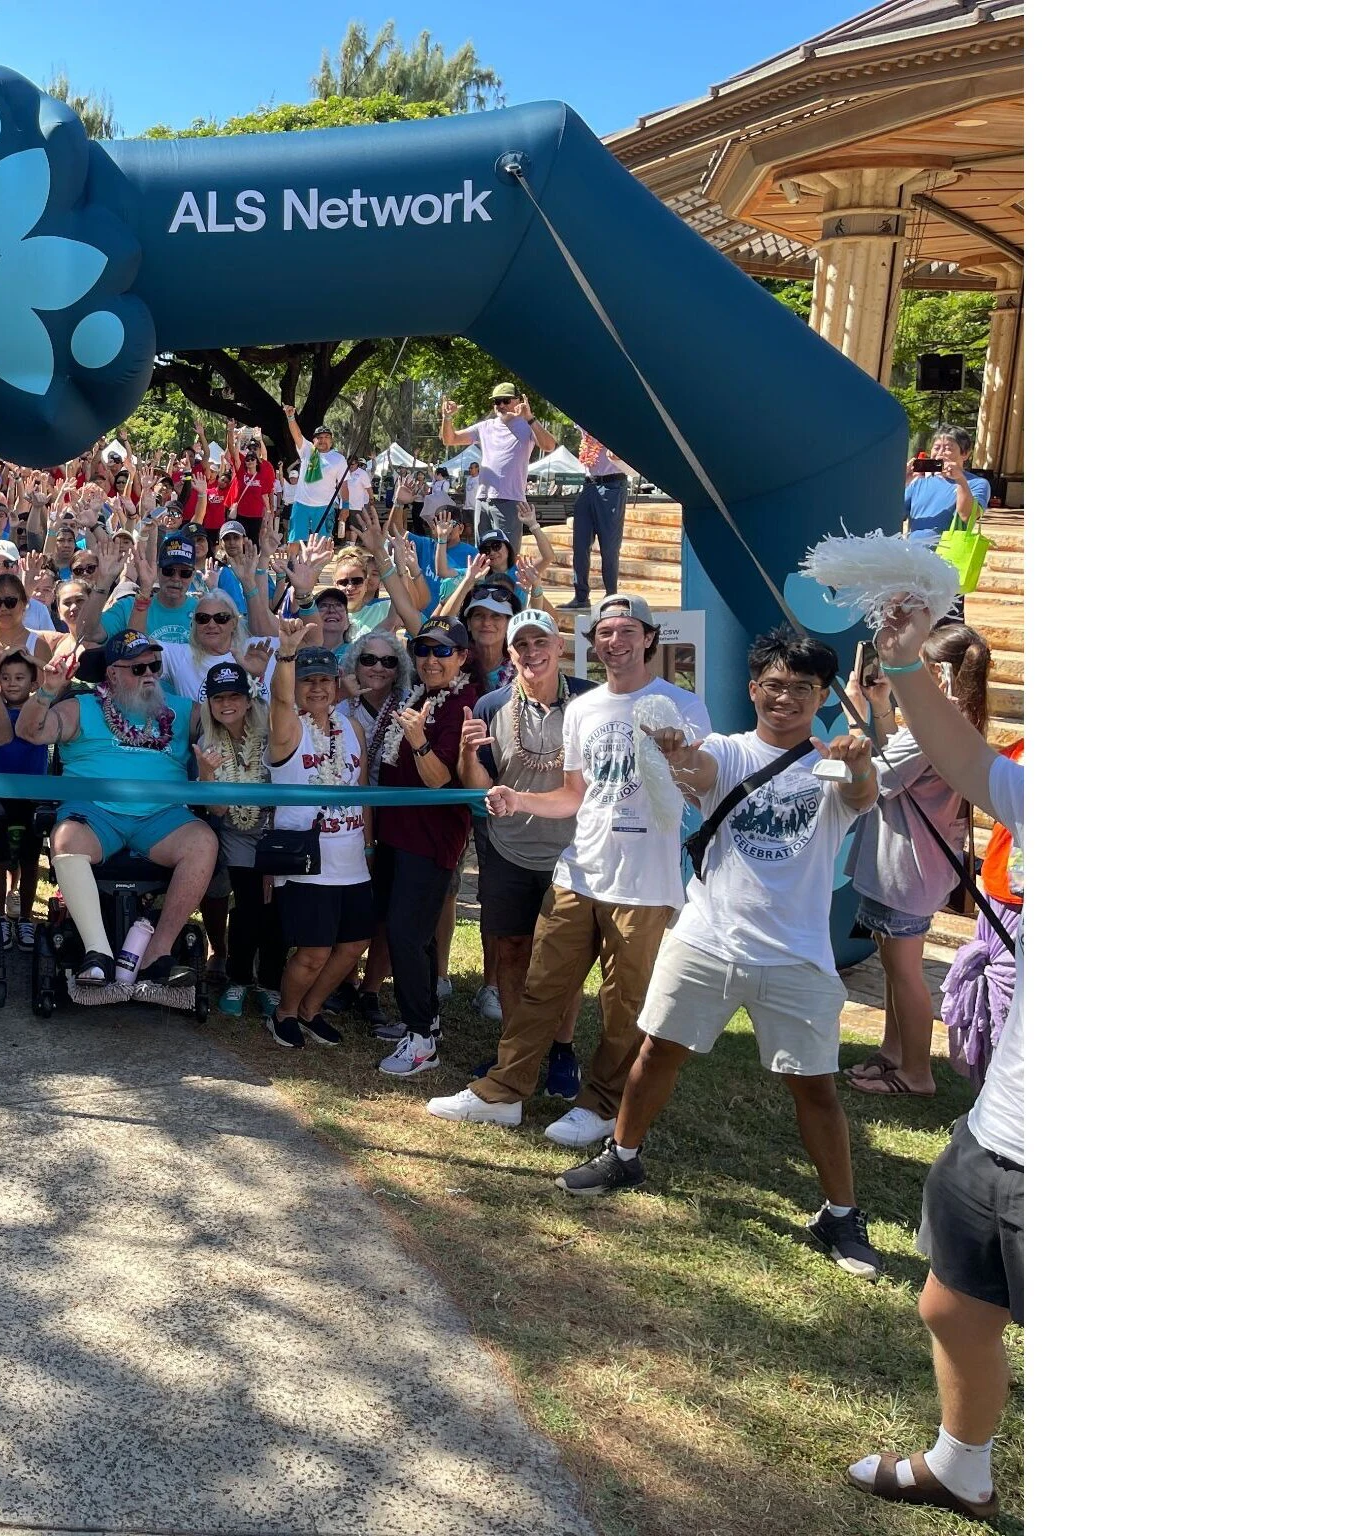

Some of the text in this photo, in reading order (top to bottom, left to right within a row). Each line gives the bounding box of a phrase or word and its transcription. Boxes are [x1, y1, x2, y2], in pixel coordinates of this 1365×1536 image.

[168, 179, 493, 233] ALS Network
[166, 550, 193, 559] VETERAN
[733, 834, 809, 859] CELEBRATION
